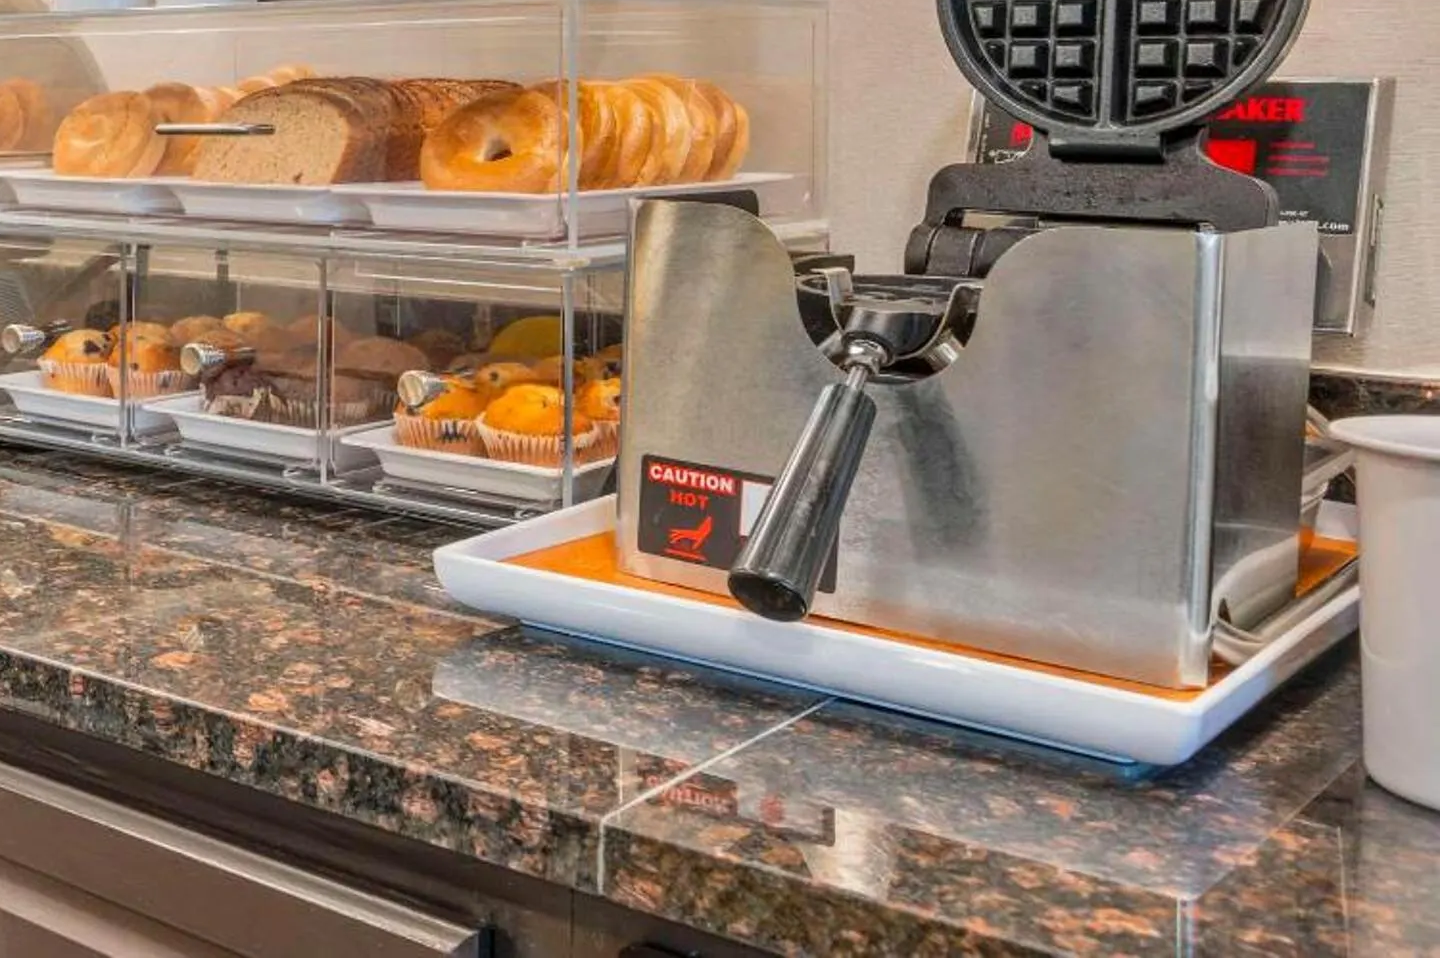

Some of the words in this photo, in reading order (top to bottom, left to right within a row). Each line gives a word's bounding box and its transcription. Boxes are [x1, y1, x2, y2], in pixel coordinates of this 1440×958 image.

[1216, 96, 1306, 122] AKER
[649, 464, 735, 492] CAUTION
[669, 489, 709, 510] HOT
